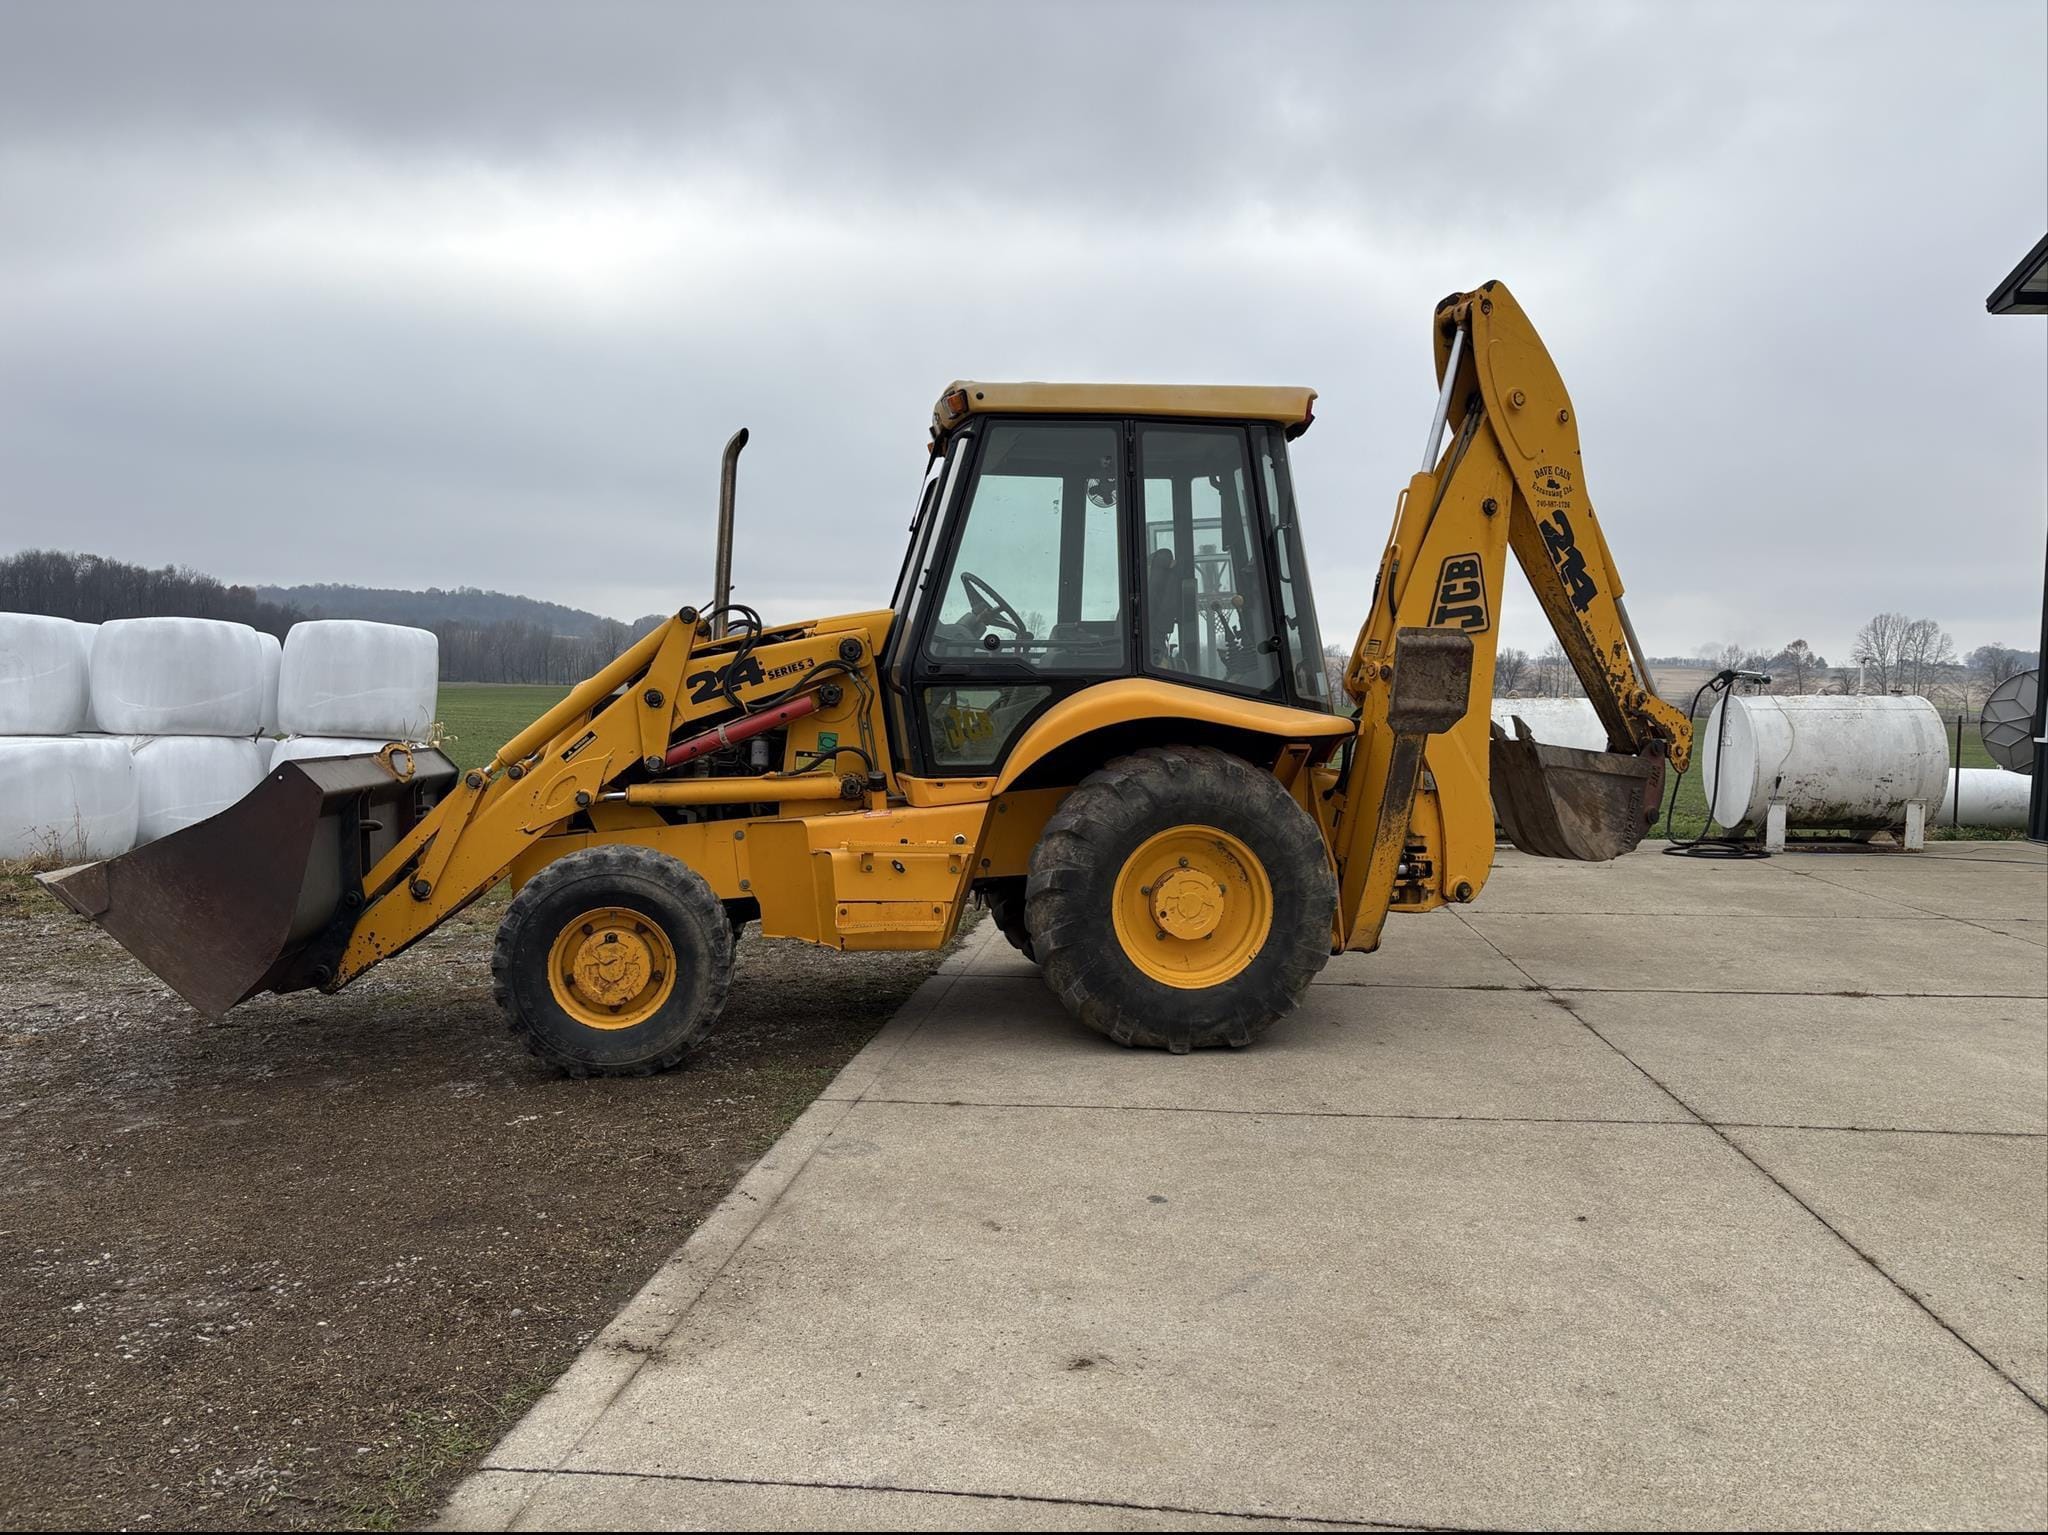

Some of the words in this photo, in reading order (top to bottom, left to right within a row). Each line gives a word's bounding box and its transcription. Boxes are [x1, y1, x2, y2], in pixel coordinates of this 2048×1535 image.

[1534, 466, 1553, 479] DAVE
[1554, 466, 1572, 481] CAIN
[1434, 559, 1485, 629] JCB
[767, 661, 806, 680] SERIES
[807, 658, 816, 668] 3
